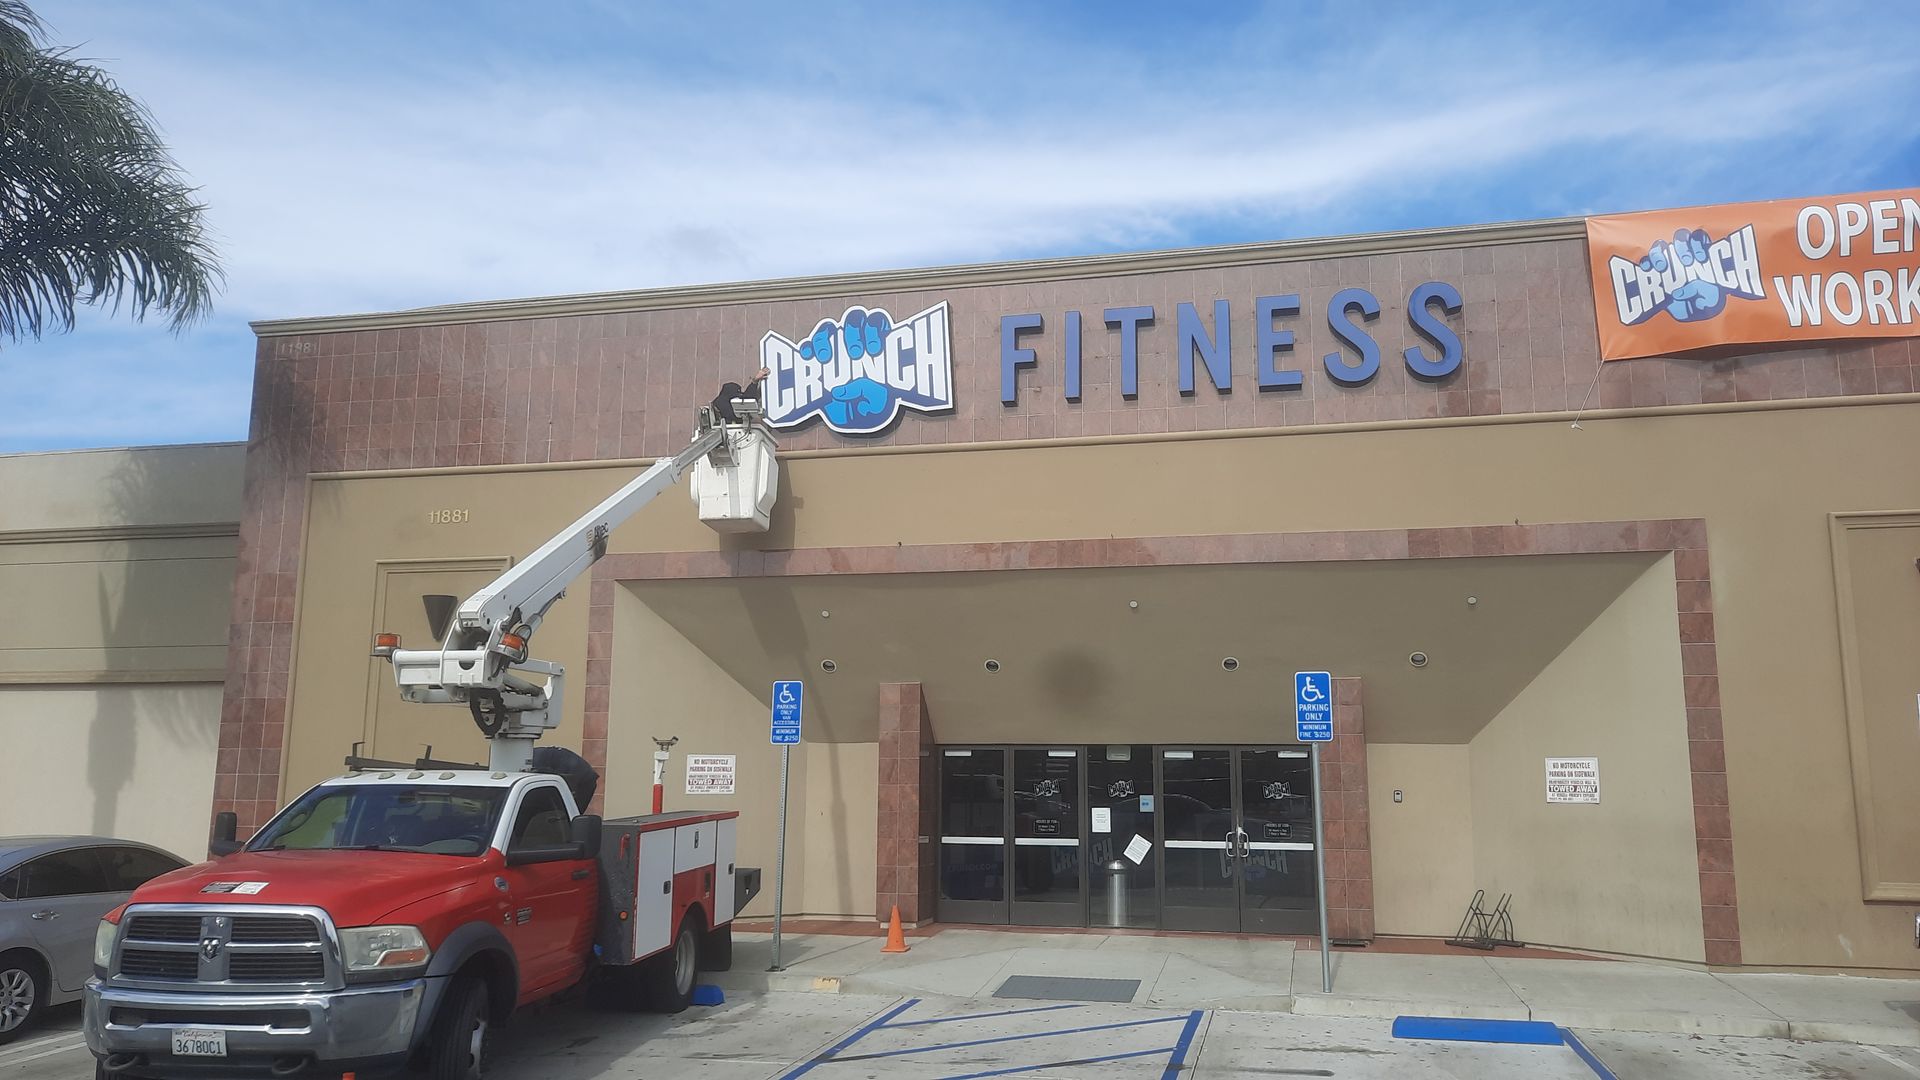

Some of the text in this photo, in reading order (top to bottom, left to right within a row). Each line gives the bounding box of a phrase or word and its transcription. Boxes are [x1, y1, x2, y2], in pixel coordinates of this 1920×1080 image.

[1608, 225, 1766, 326] CRUNCH
[1774, 267, 1920, 327] WORK
[763, 281, 1464, 422] CRUNCH FITNESS
[428, 509, 469, 524] 11881
[1298, 703, 1329, 712] PARKING
[1305, 712, 1324, 721] ONLY
[1548, 770, 1567, 778] PARKING
[1574, 770, 1595, 778] SIDEWALK
[1549, 785, 1597, 793] TOWED AWAY
[175, 1038, 223, 1055] 36780C1
